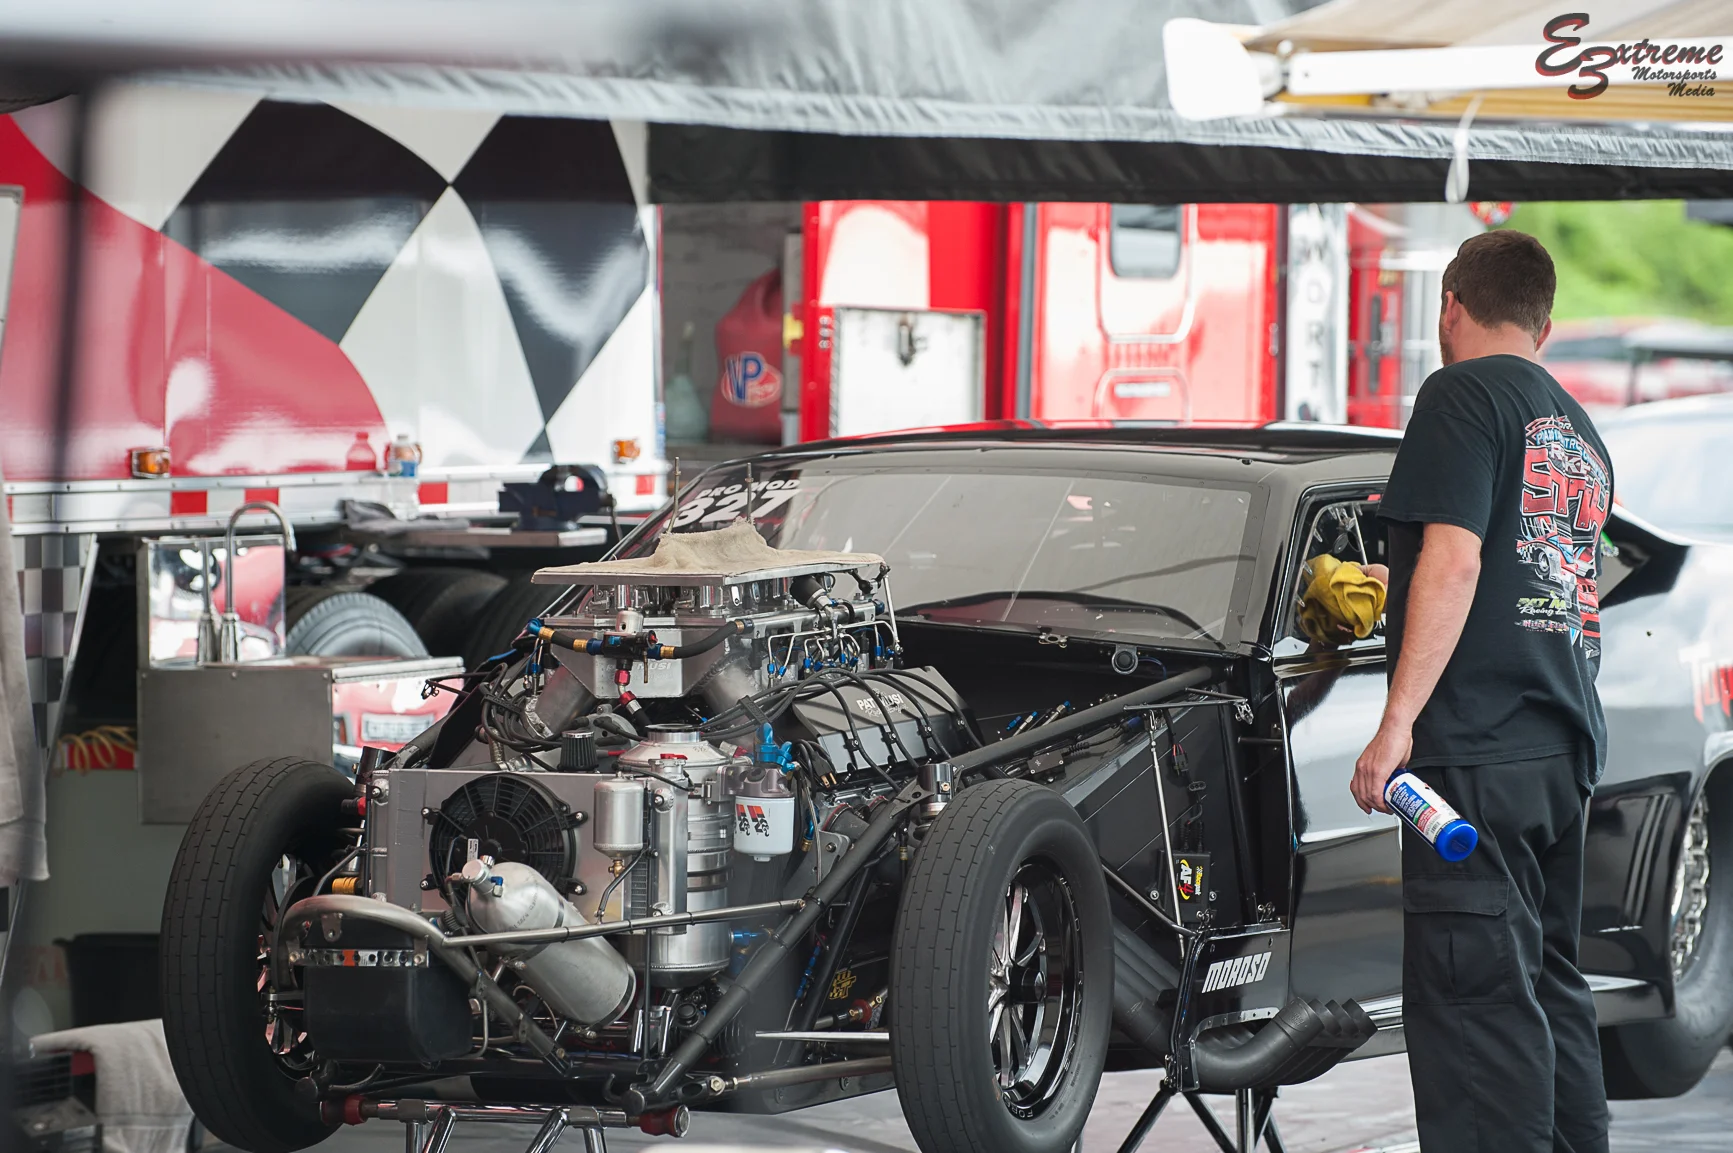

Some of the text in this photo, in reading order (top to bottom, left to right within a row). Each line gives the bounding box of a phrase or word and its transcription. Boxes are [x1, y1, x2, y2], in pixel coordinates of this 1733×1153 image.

[725, 352, 765, 401] VP
[662, 488, 802, 530] 327
[695, 478, 801, 501] PRO MOD
[1177, 863, 1195, 894] AF4
[1201, 951, 1272, 994] MOROSO
